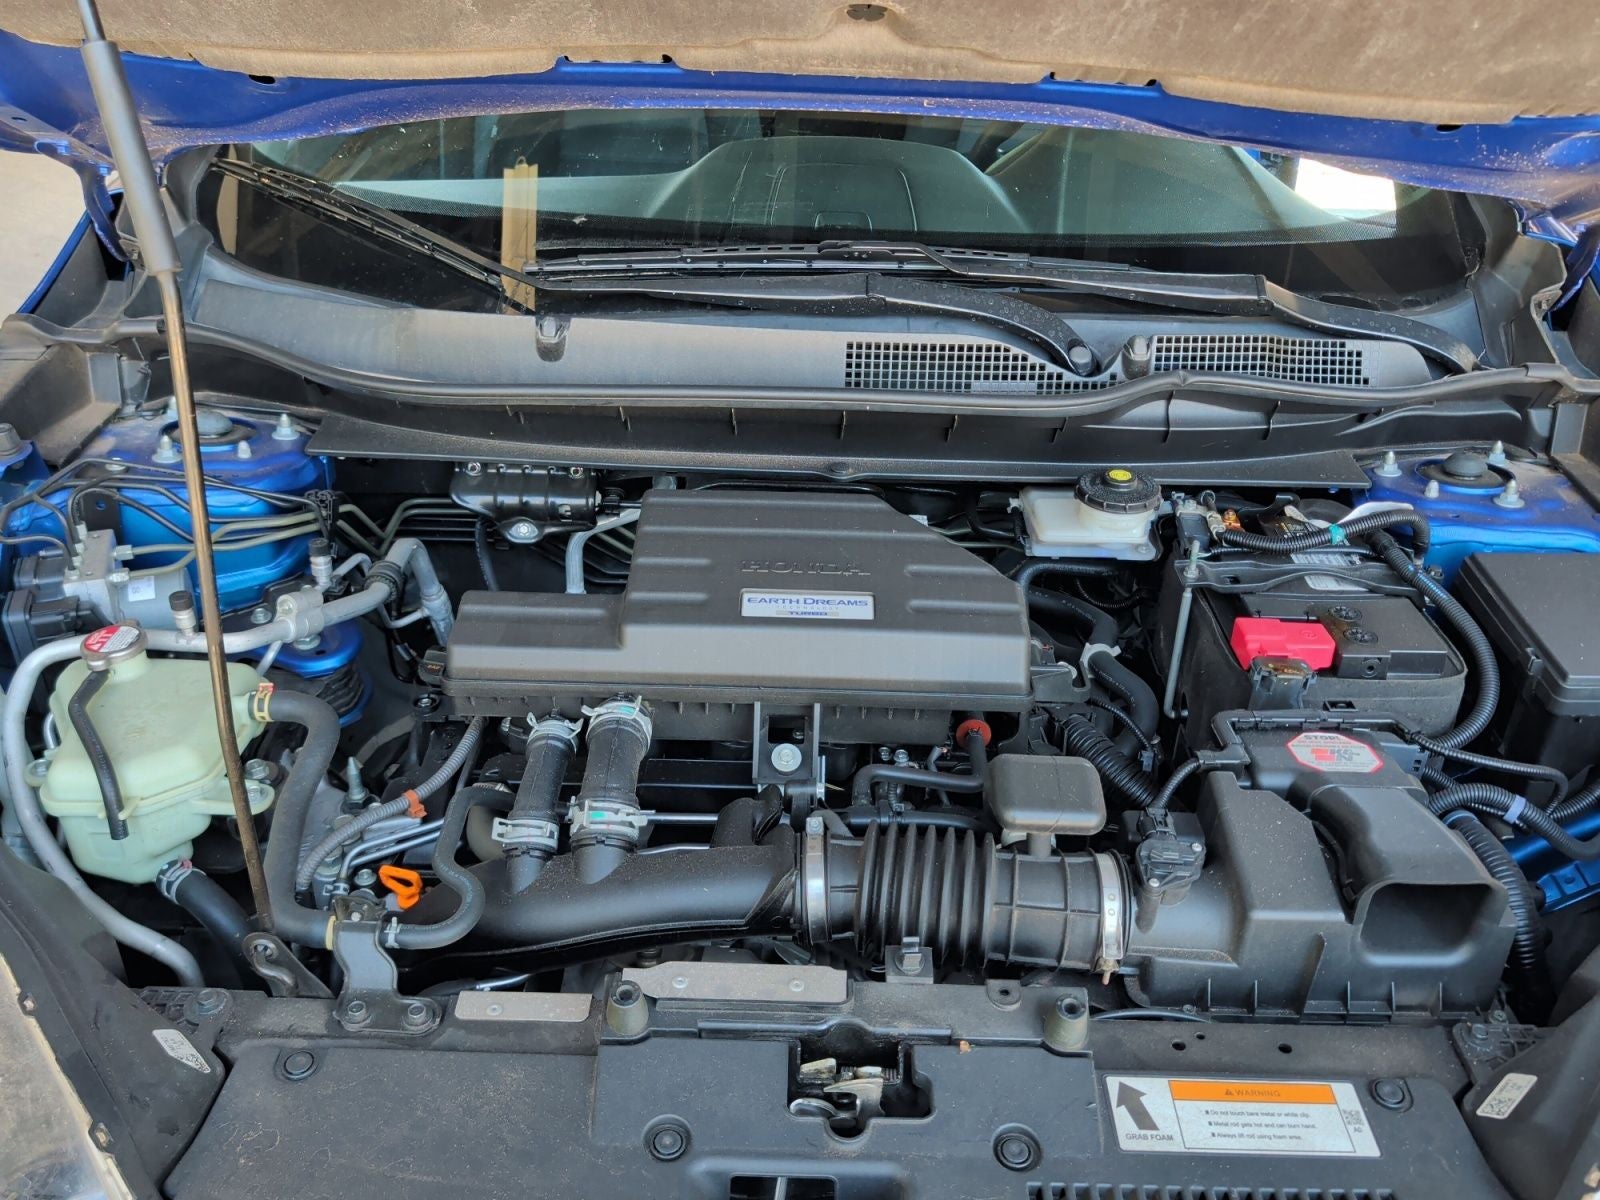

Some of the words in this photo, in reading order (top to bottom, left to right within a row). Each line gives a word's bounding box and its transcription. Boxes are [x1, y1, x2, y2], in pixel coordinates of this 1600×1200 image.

[741, 560, 871, 576] HONDA
[747, 597, 800, 605] EARTH
[803, 597, 868, 607] DREAMS
[1234, 1089, 1281, 1097] WARNING
[1125, 1132, 1149, 1141] GRAB
[1149, 1133, 1174, 1142] FOAM
